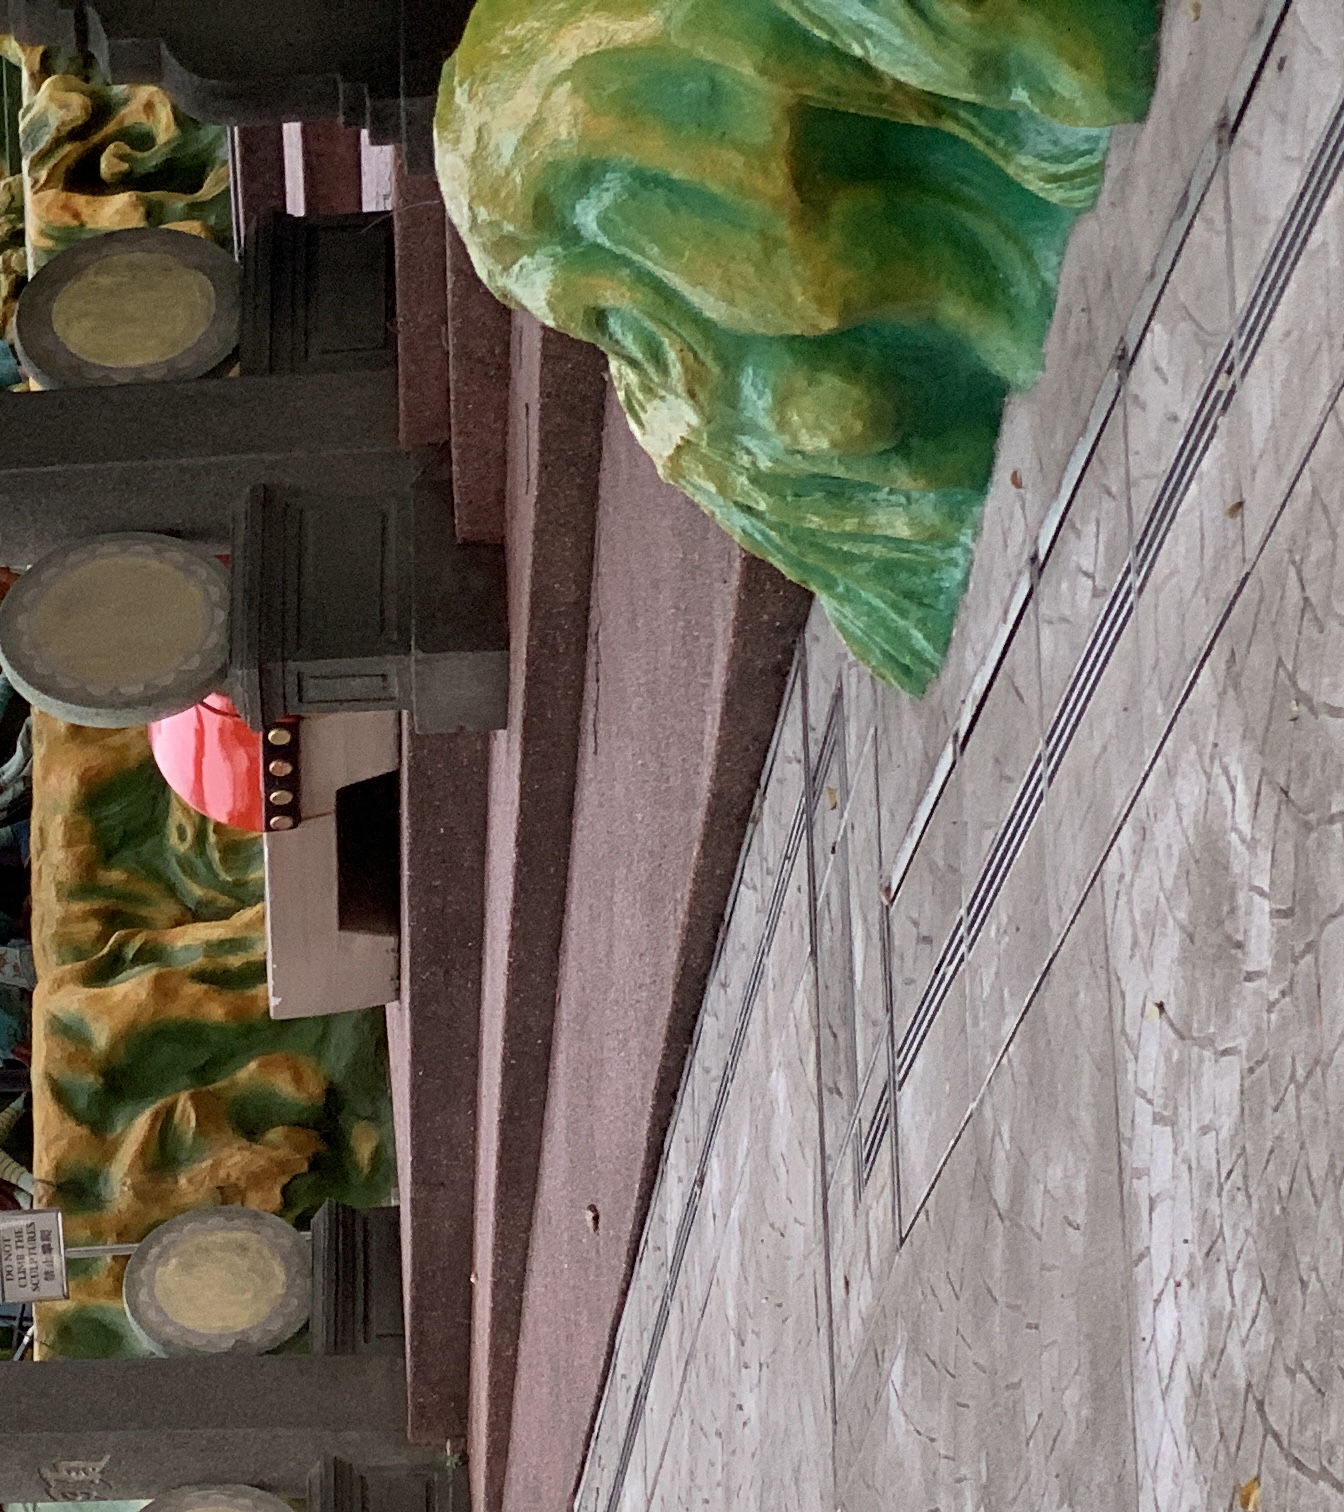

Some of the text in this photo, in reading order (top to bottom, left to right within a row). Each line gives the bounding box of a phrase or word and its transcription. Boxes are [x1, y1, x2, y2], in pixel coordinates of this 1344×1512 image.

[2, 1236, 14, 1282] DO NOT
[14, 1227, 27, 1289] CLIMB THE
[25, 1221, 41, 1293] SCULPTURES
